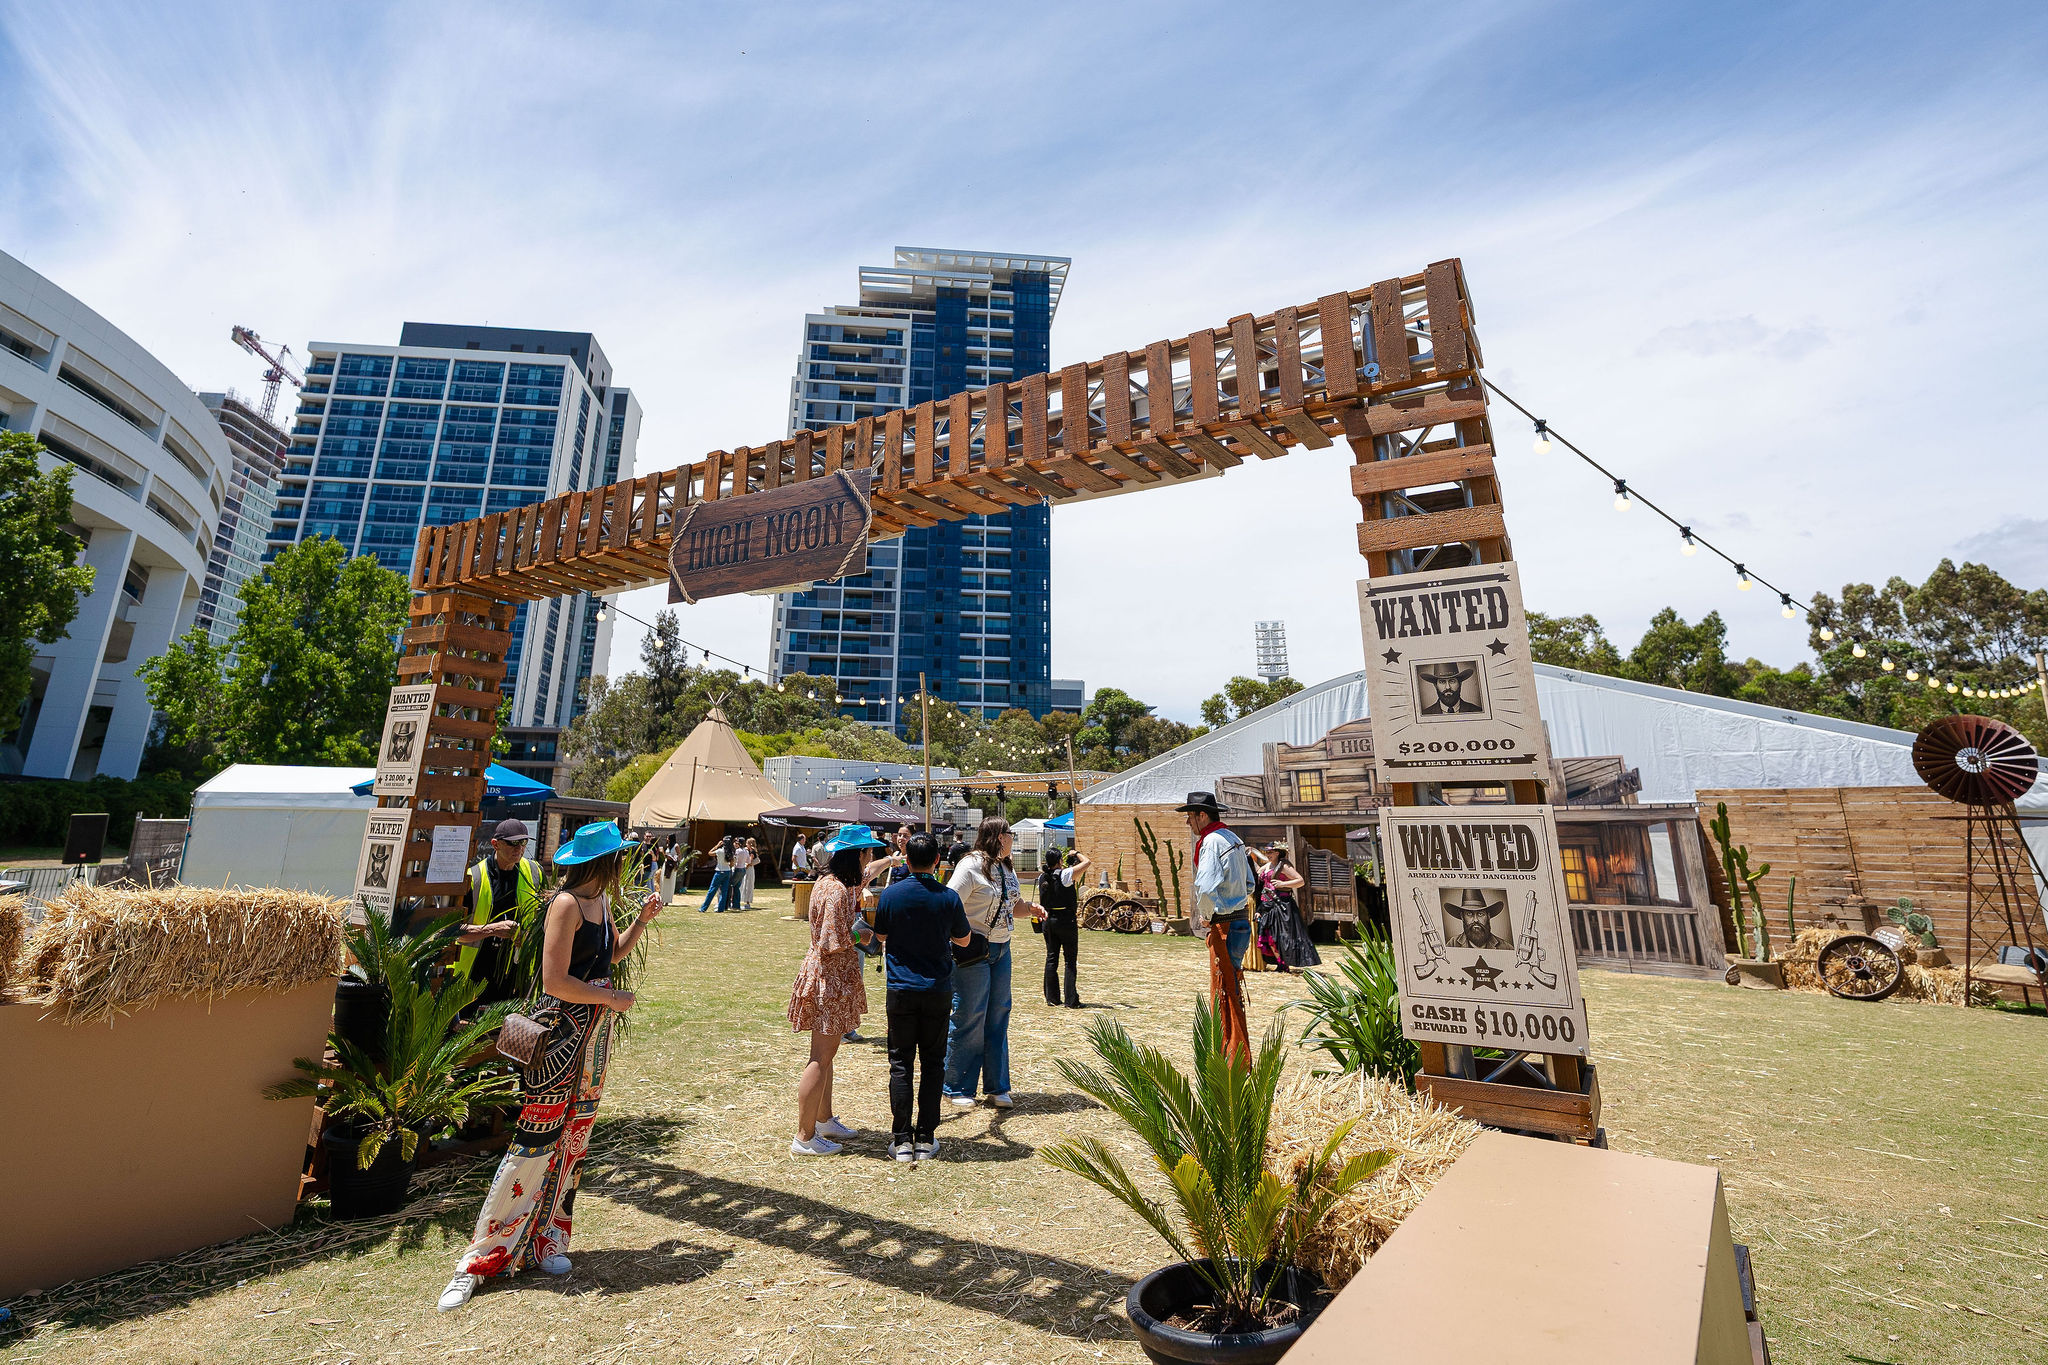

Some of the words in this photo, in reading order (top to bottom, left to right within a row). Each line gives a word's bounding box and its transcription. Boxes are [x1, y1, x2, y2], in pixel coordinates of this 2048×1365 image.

[687, 520, 755, 572] HIGH
[763, 501, 846, 559] NOON
[1370, 585, 1510, 640] WANTED
[393, 692, 431, 705] WANTED
[1341, 737, 1374, 754] HIG
[1398, 738, 1516, 756] $200,000
[369, 822, 403, 836] WANTED
[1397, 824, 1540, 871] WANTED
[1482, 873, 1537, 881] DANGEROUS
[1411, 1004, 1467, 1023] CASH
[1414, 1021, 1468, 1035] REWARD
[1474, 1004, 1576, 1043] $10,000
